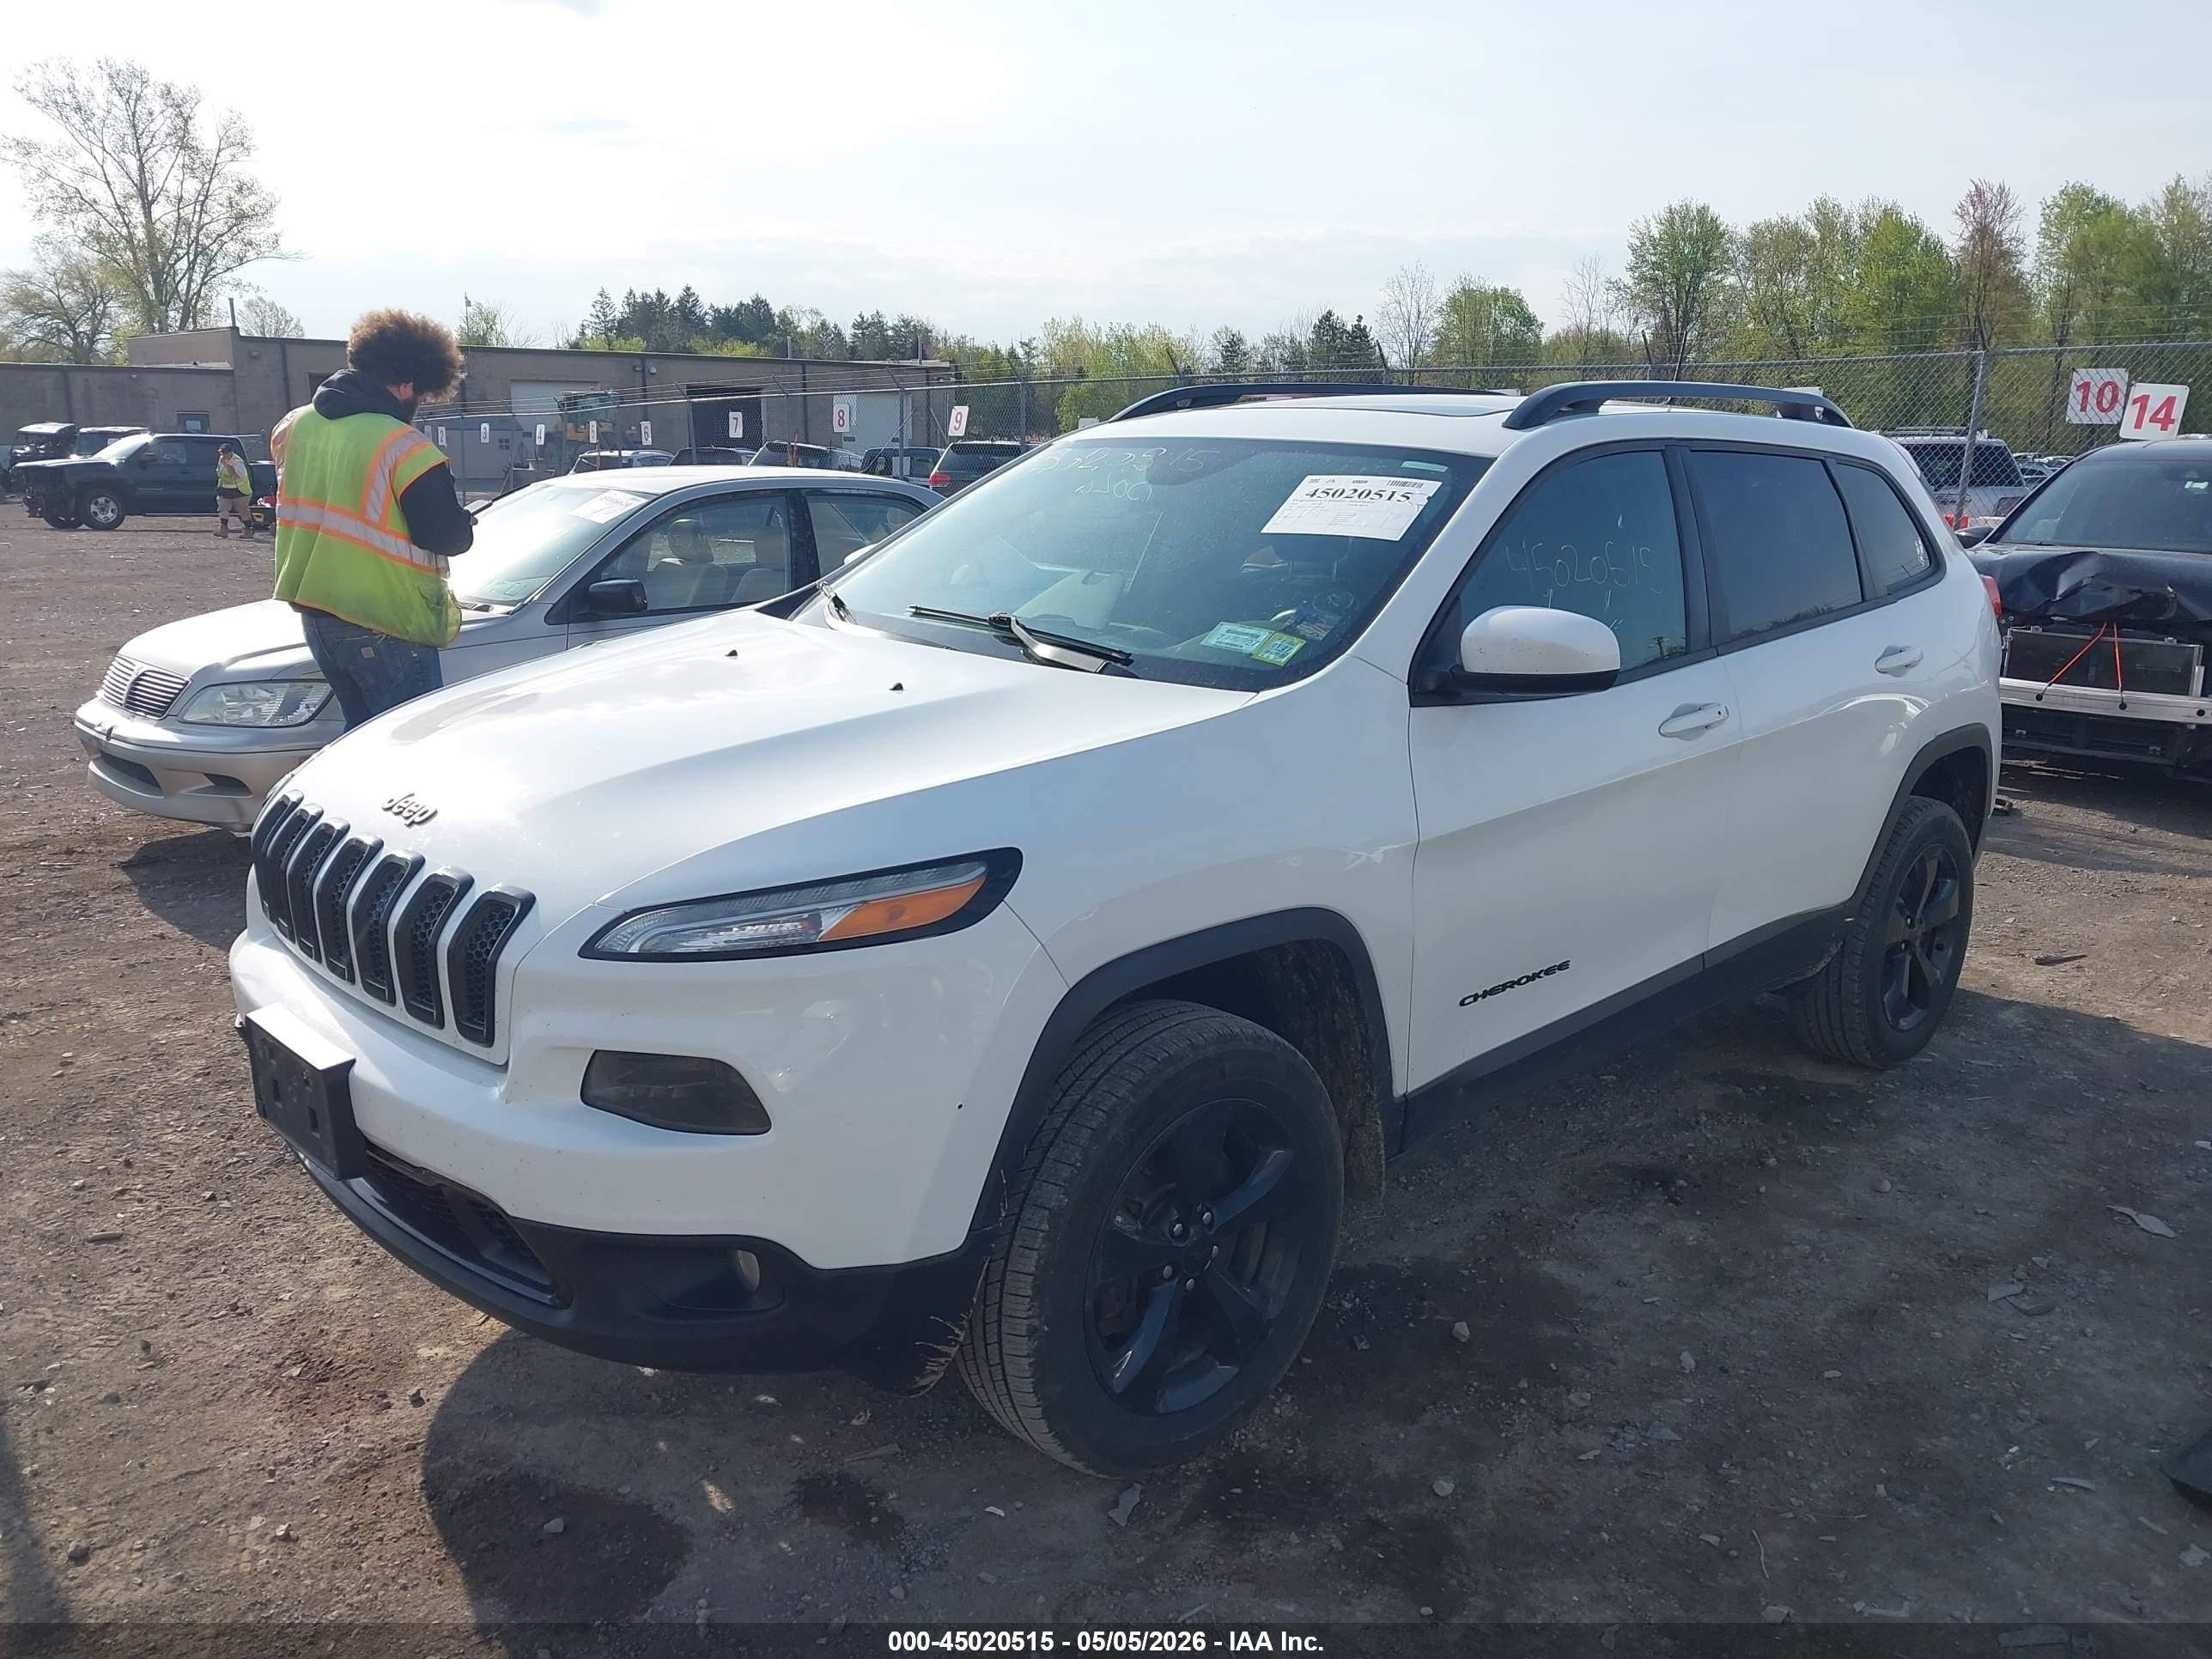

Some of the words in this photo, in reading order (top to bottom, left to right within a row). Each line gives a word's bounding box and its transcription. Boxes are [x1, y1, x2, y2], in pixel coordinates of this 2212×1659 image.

[2076, 380, 2118, 413] 10
[836, 410, 845, 428] 8
[952, 411, 963, 432] 9
[2131, 394, 2177, 431] 14
[482, 425, 488, 440] 3
[537, 426, 544, 441] 4
[643, 426, 649, 441] 6
[732, 417, 738, 434] 7
[440, 429, 444, 442] 2
[1305, 487, 1413, 502] 45020515
[1504, 540, 1663, 594] 45020515
[381, 793, 438, 828] Jeep
[1459, 959, 1571, 1006] CHEROKEE
